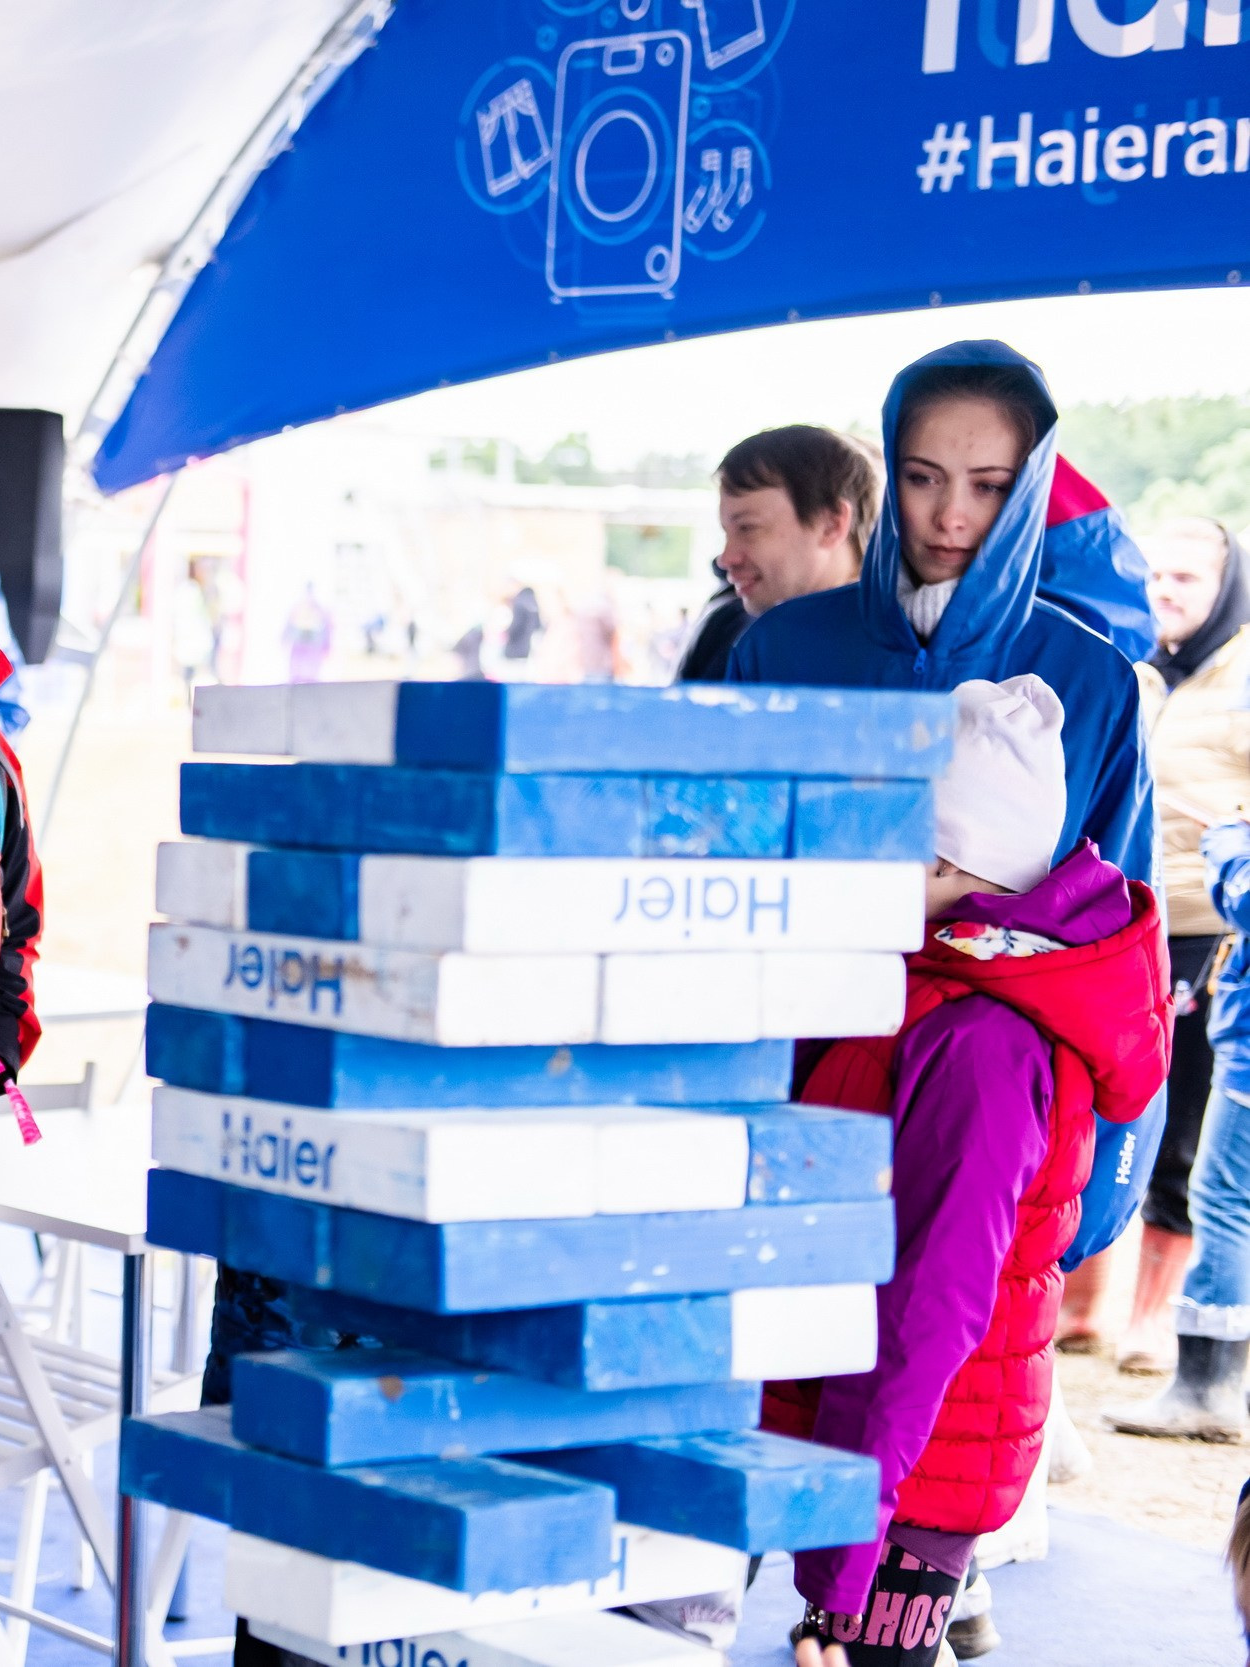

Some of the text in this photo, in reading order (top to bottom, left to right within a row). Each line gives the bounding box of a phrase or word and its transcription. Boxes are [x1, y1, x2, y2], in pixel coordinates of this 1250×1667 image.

[614, 876, 790, 938] Haier
[224, 943, 344, 1016] Haier
[222, 1111, 337, 1191] Haier
[1115, 1131, 1136, 1185] Haier
